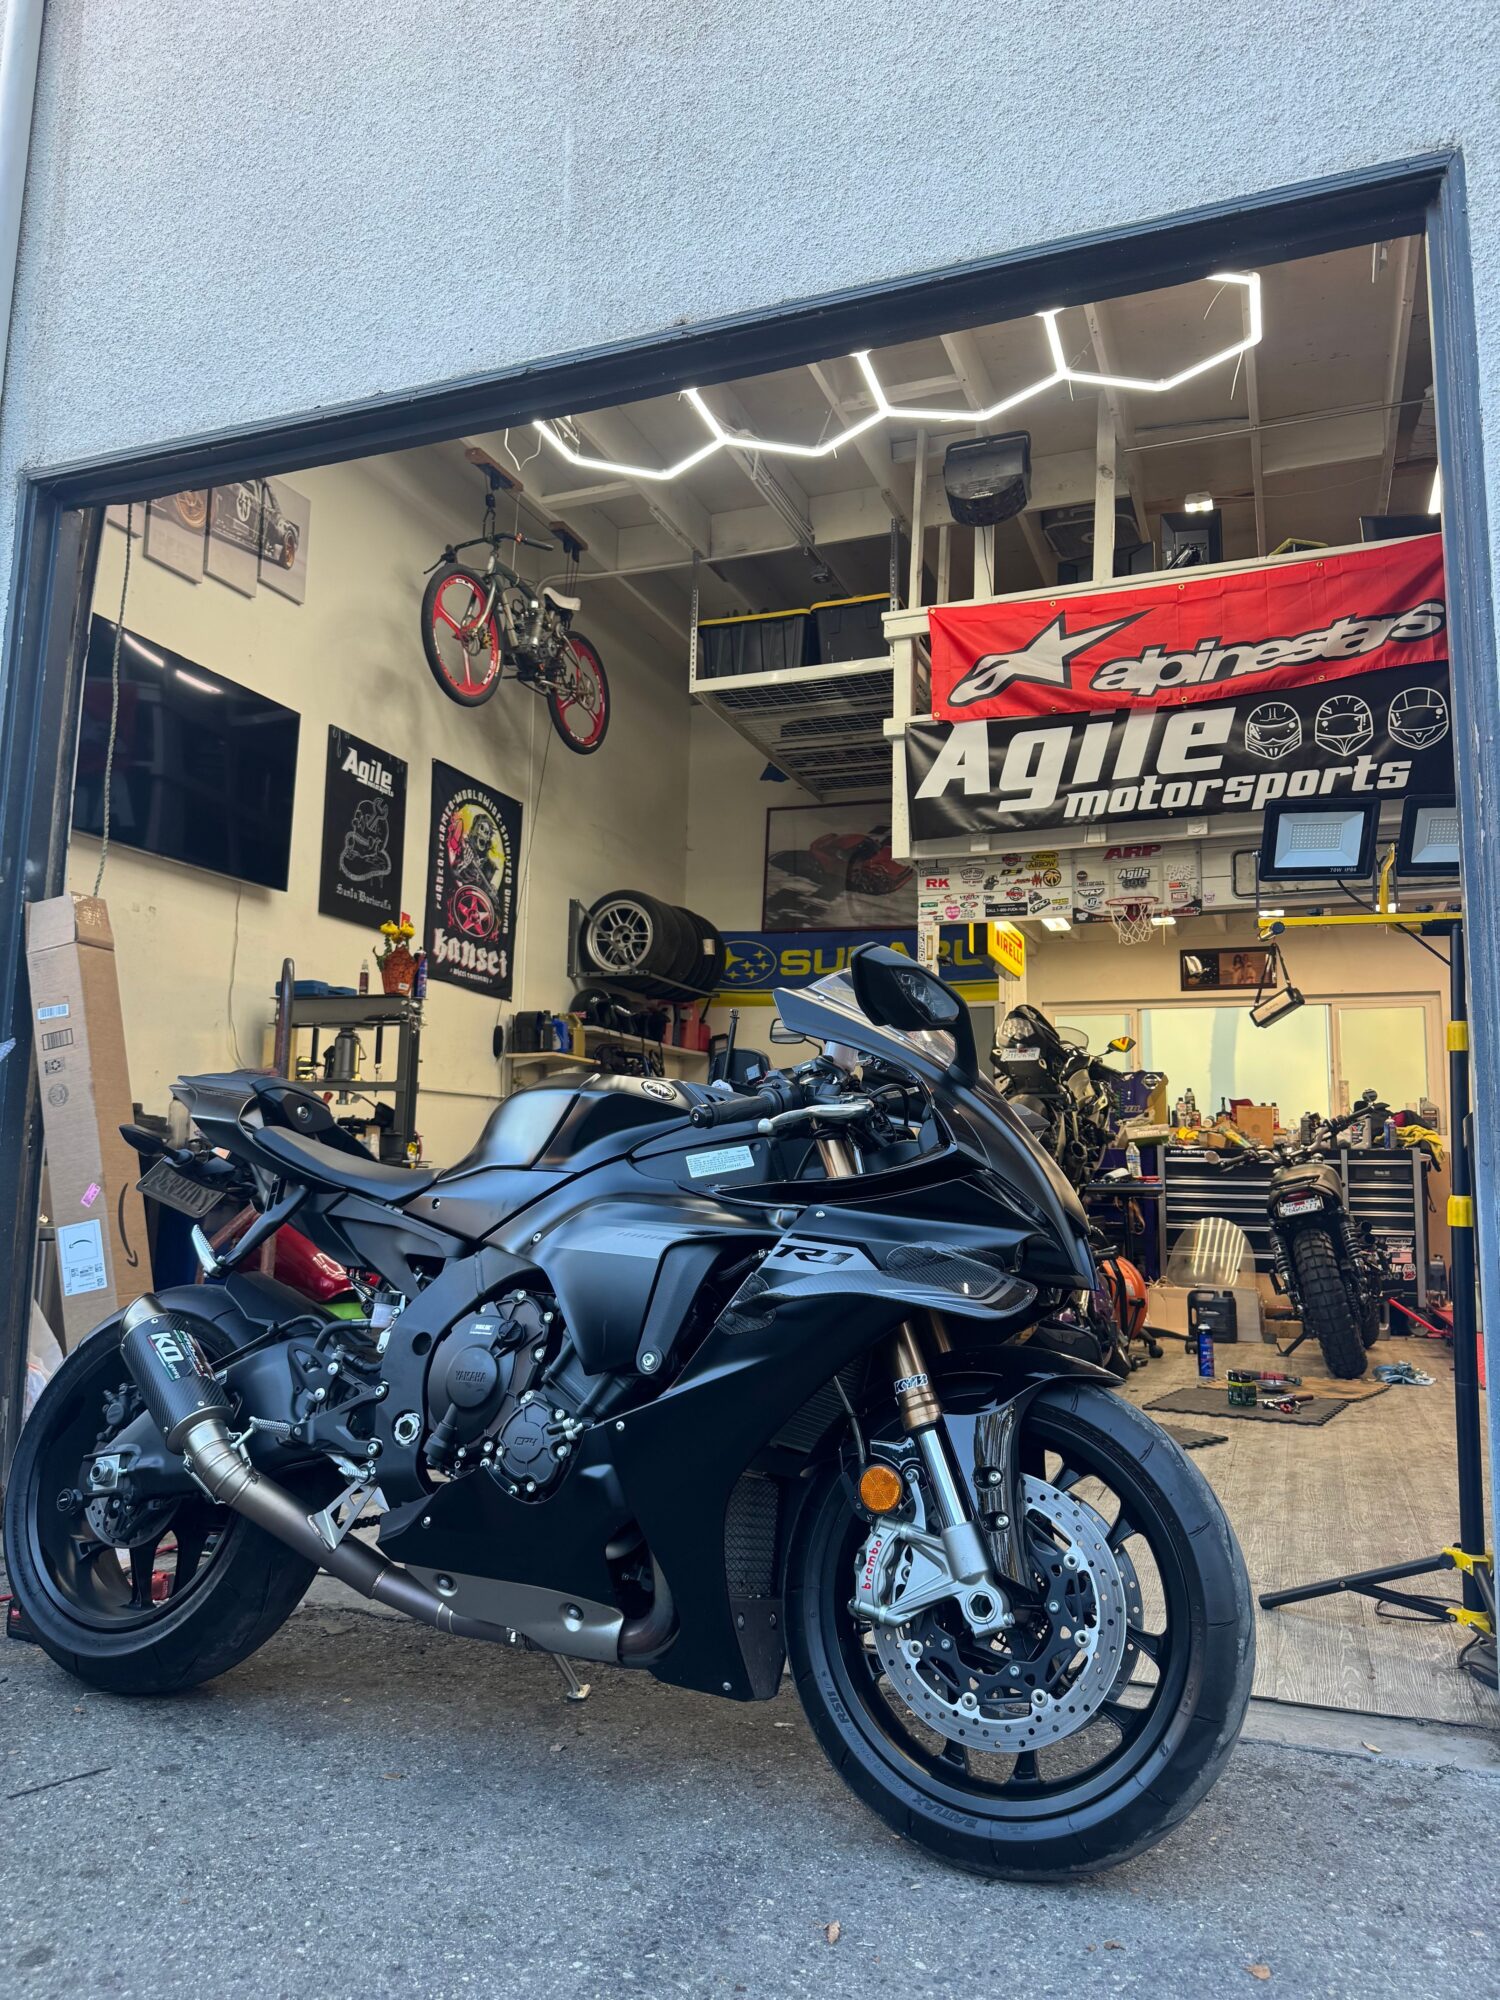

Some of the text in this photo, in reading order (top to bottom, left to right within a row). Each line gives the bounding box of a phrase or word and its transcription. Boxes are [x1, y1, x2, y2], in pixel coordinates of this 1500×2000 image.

[1089, 602, 1446, 697] alpinestars
[342, 746, 393, 789] Agile
[915, 704, 1237, 812] Agile
[1063, 755, 1412, 818] motorsports
[1103, 844, 1162, 861] ARP
[925, 878, 950, 888] RK
[1118, 867, 1151, 880] Agile
[149, 1332, 185, 1362] KO
[455, 1369, 487, 1382] YAMAHA
[893, 1372, 929, 1394] KYB
[861, 1538, 882, 1590] brembo
